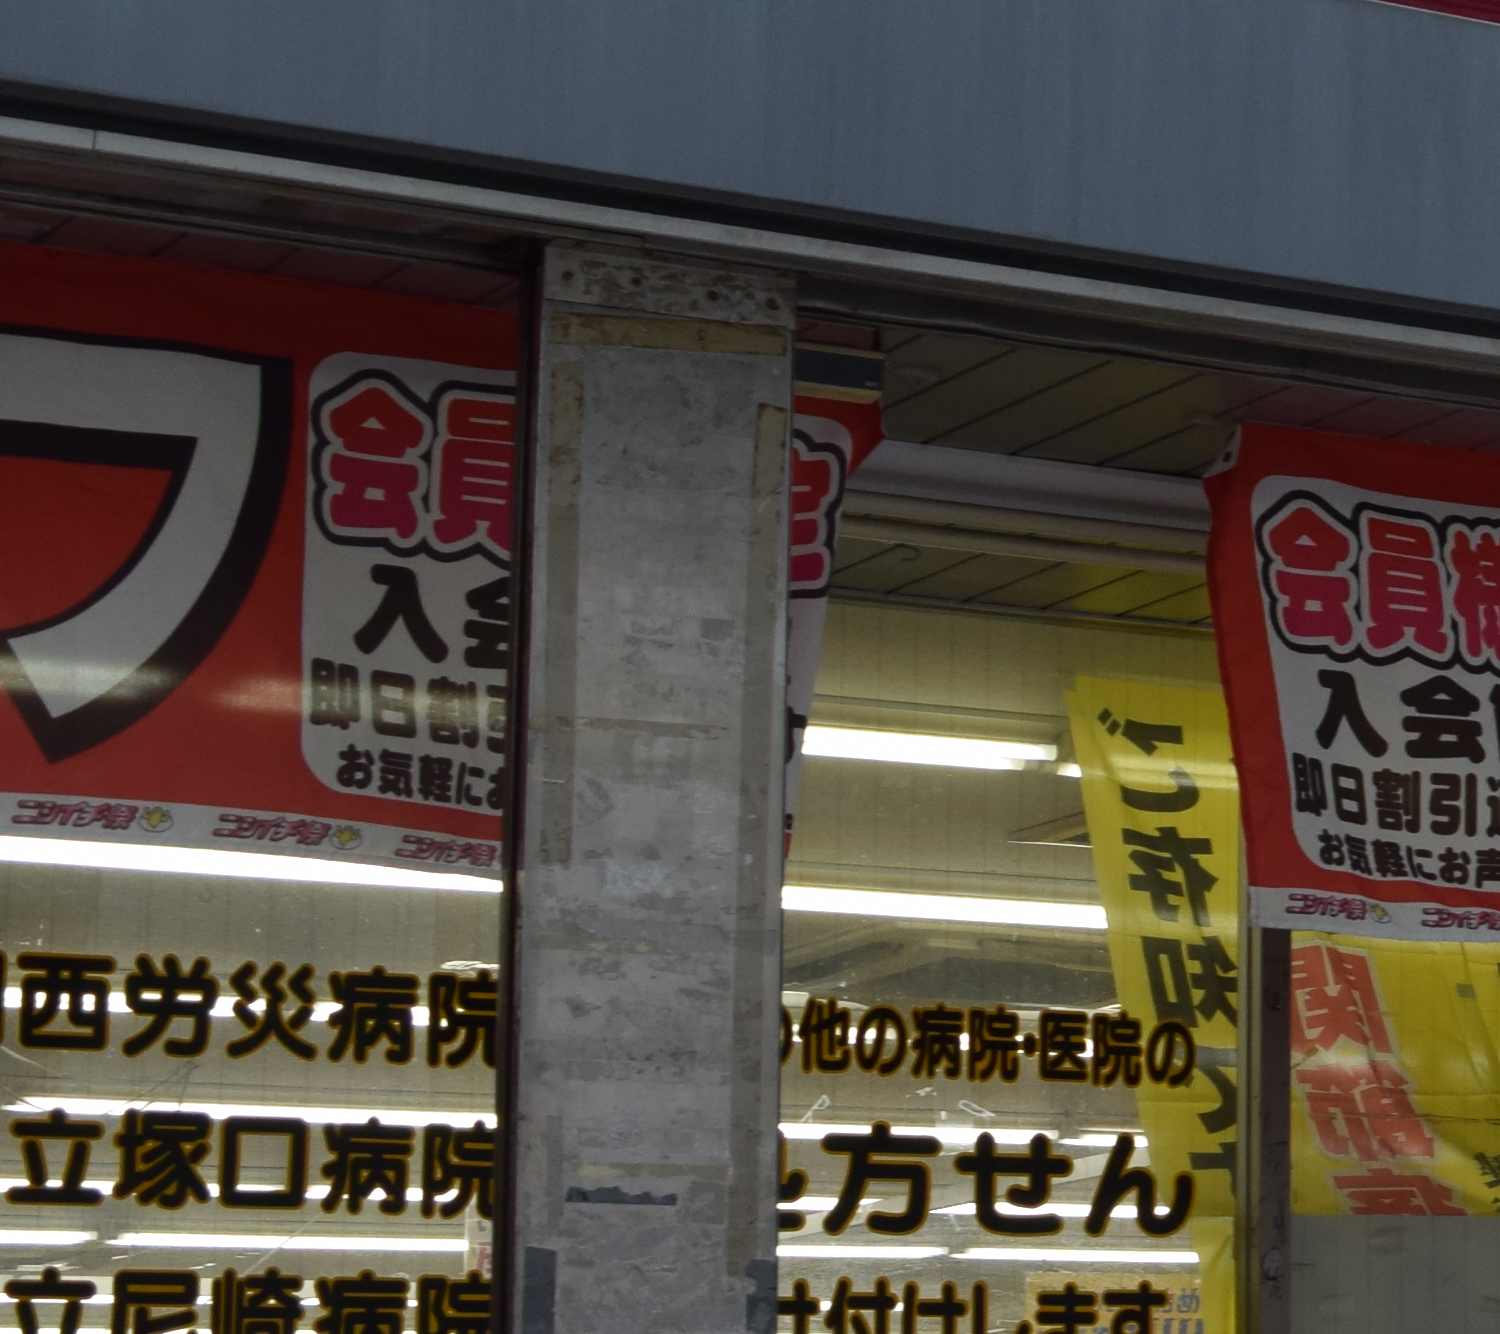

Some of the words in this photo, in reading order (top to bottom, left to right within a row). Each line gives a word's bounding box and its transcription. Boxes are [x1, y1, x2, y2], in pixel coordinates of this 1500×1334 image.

[0, 952, 499, 1067] 西労災病院
[778, 1119, 1197, 1238] 方せん
